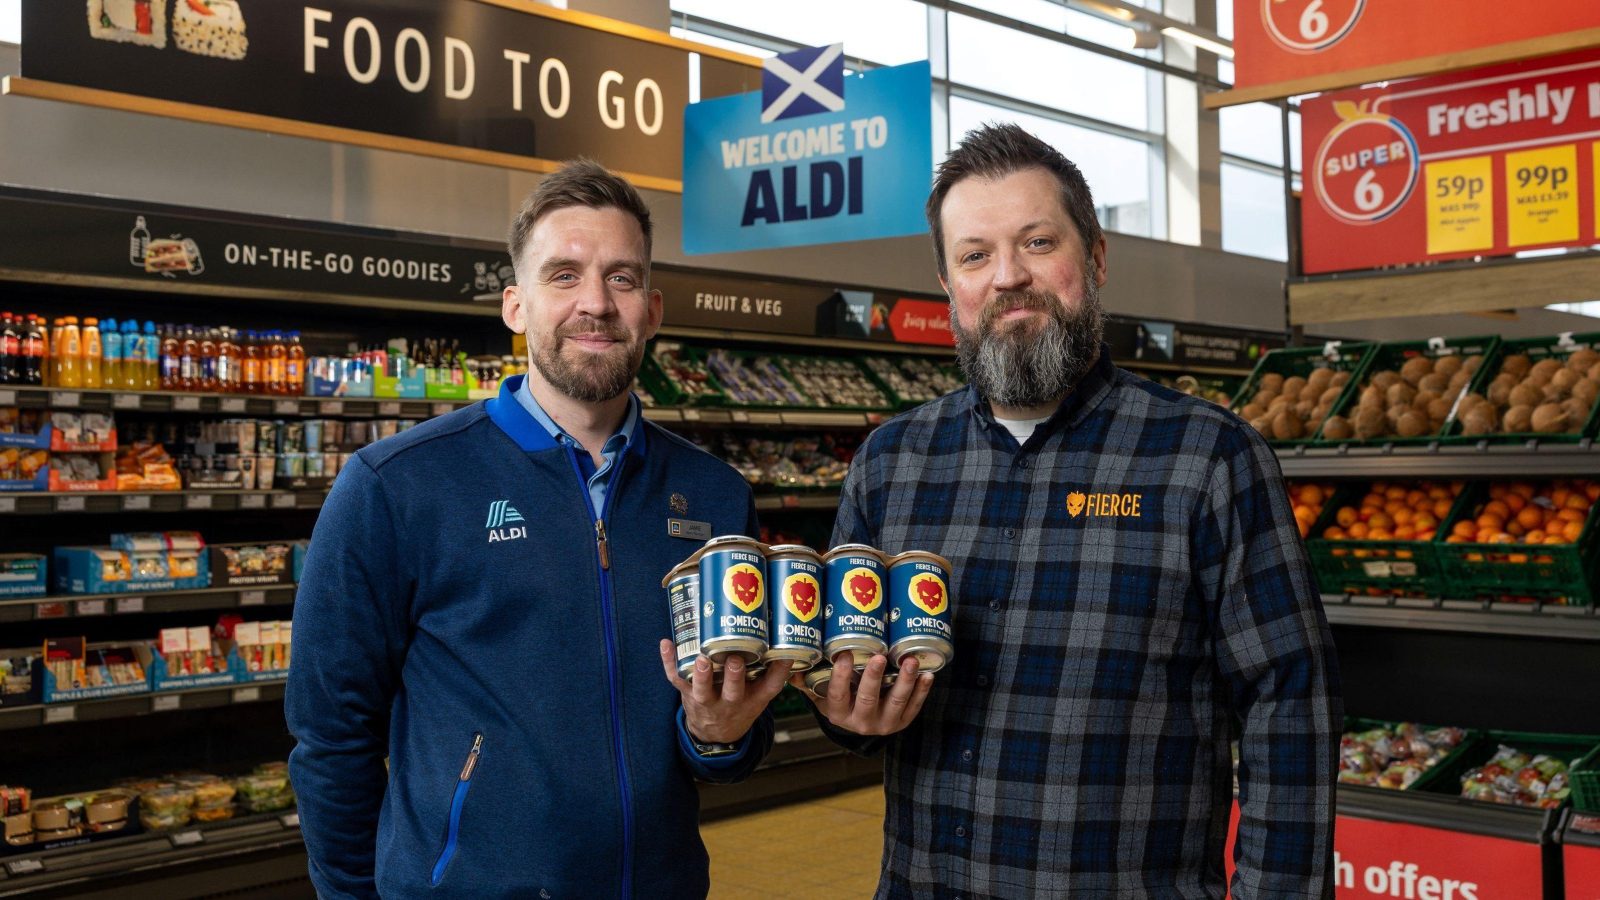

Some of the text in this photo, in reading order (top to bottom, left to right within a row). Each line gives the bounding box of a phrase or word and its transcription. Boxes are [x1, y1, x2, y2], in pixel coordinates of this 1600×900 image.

[1299, 0, 1329, 40] 6
[303, 7, 665, 137] FOOD TO GO
[1427, 82, 1576, 137] Freshly
[721, 115, 888, 170] WELCOME TO
[1325, 140, 1406, 177] SUPER
[741, 157, 863, 227] ALDI
[1354, 169, 1384, 211] 6
[1436, 175, 1484, 200] 59p
[1516, 165, 1568, 190] 99p
[224, 243, 452, 285] ON-THE-GO GOODIES
[695, 293, 782, 316] FRUIT & VEG
[1086, 493, 1142, 517] FIERCE
[488, 526, 527, 543] ALDI
[731, 552, 759, 563] FIERCE BEER
[791, 562, 817, 573] FIERCE BEER
[850, 557, 877, 568] FIERCE BEER
[916, 563, 942, 574] FIERCE BEER
[1364, 861, 1478, 900] offers
